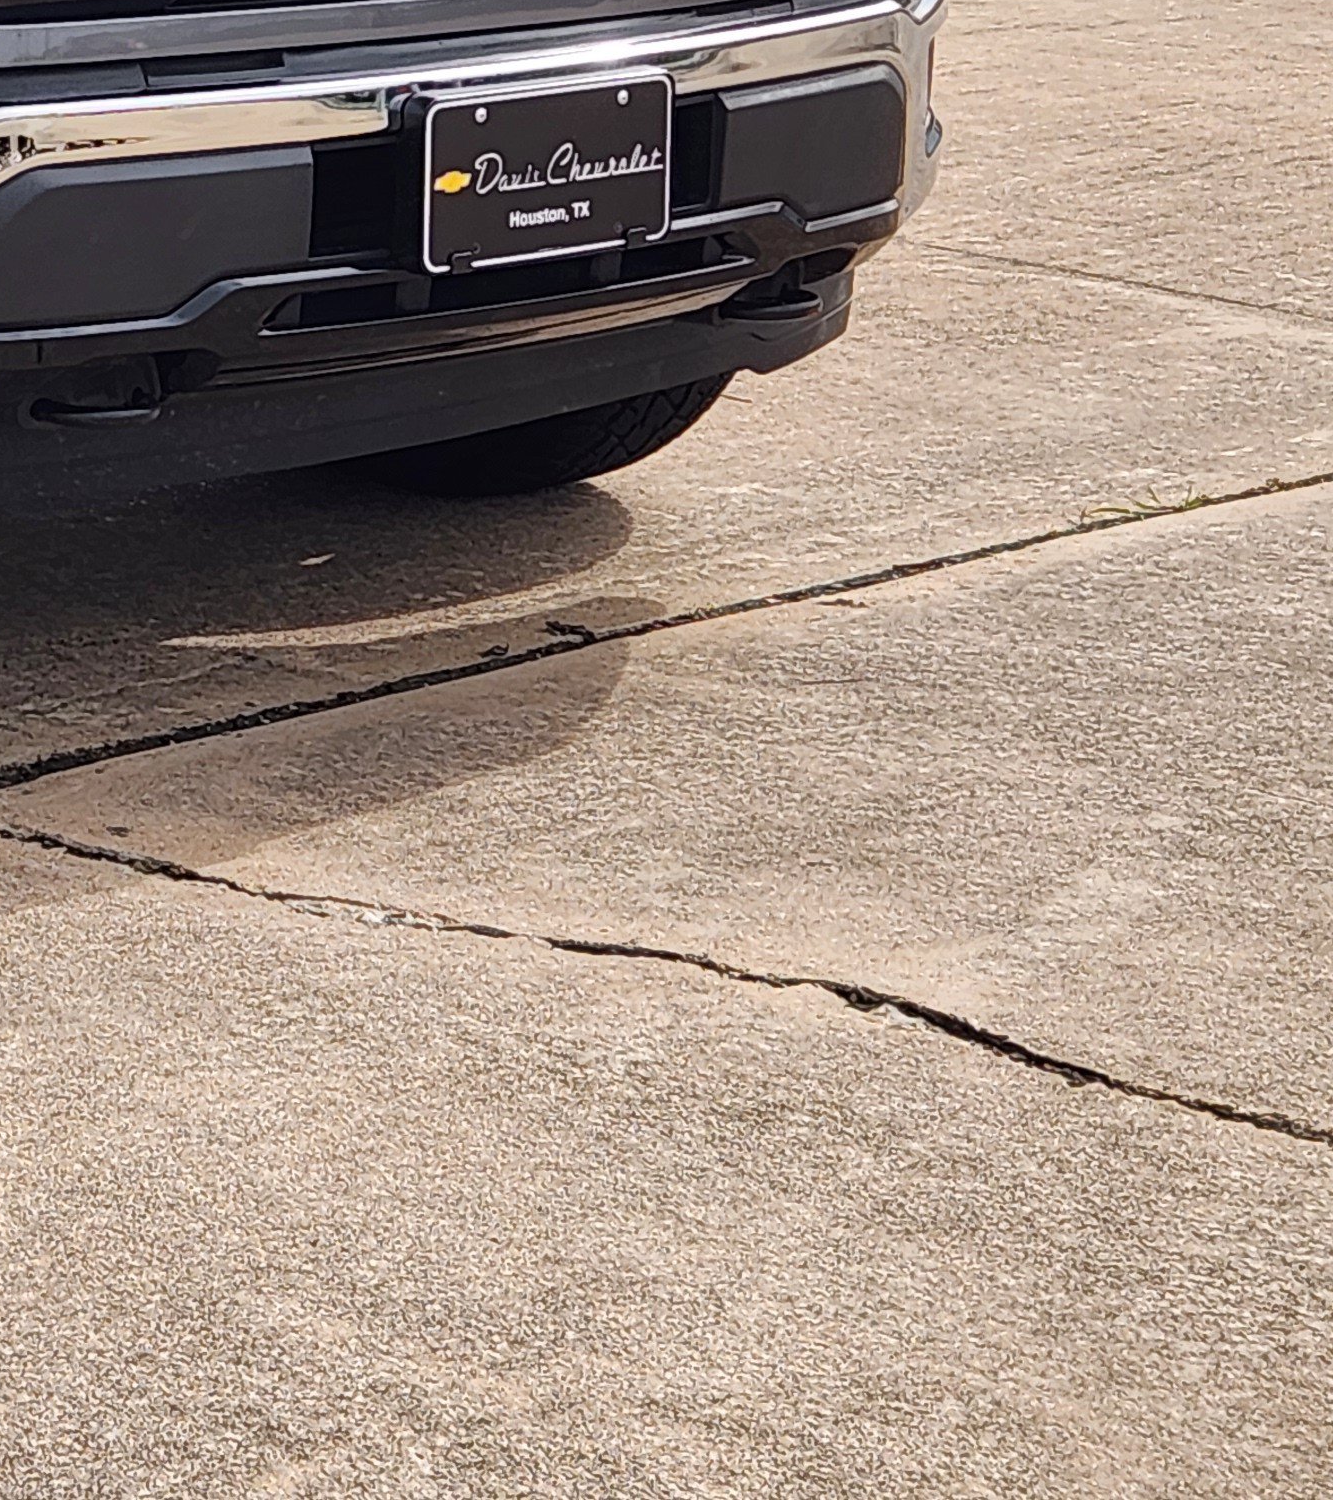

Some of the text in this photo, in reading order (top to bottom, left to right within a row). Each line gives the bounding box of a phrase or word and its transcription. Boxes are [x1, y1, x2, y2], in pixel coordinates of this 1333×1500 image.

[475, 142, 664, 194] Davis Chevrolet
[509, 200, 591, 228] Houston, TX
